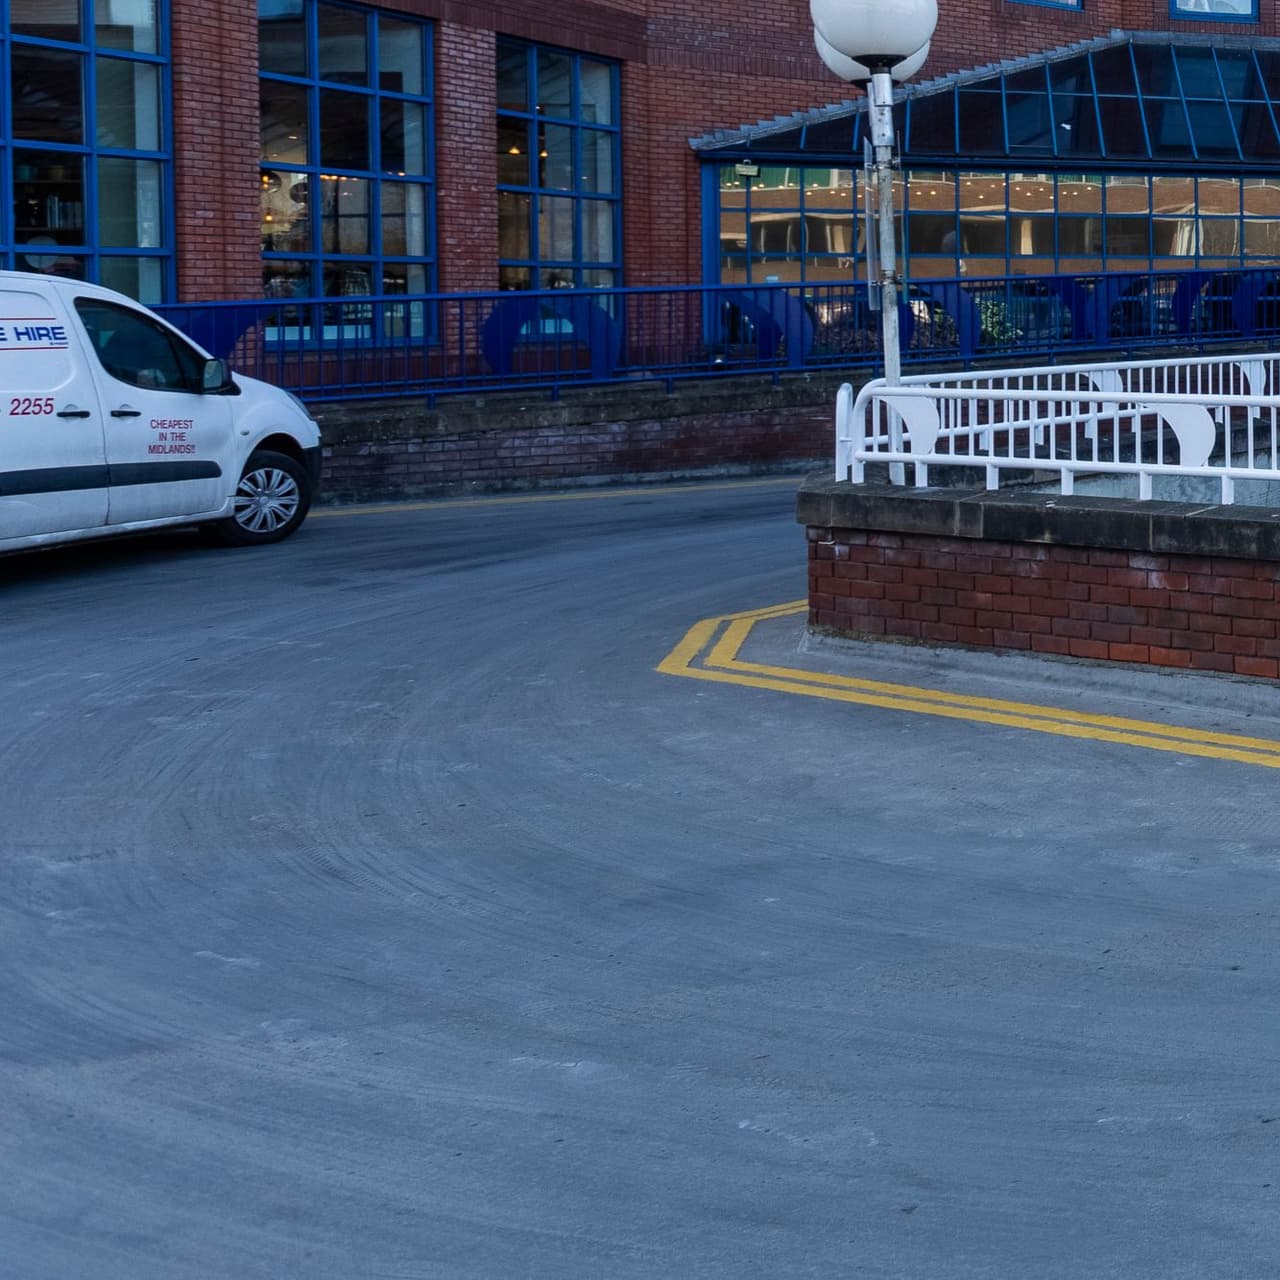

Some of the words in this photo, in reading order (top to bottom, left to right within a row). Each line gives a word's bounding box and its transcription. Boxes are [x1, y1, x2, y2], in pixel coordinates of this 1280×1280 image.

[13, 326, 67, 341] HIRE
[9, 397, 54, 416] 2255
[150, 419, 193, 429] CHEAPEST
[158, 432, 167, 441] IN
[170, 432, 186, 441] THE
